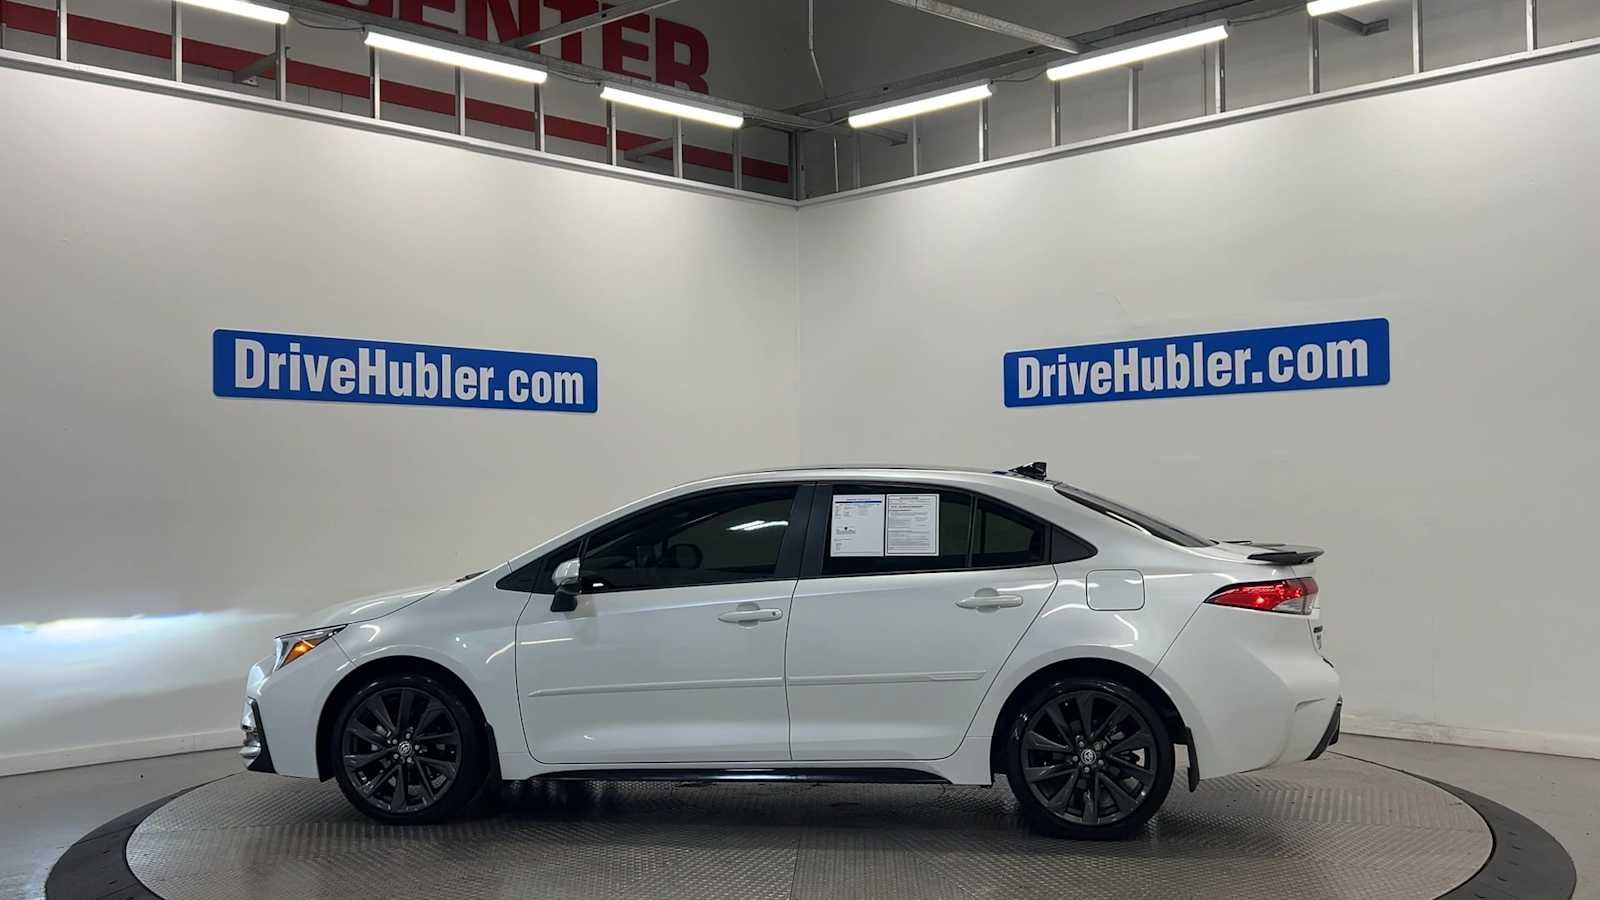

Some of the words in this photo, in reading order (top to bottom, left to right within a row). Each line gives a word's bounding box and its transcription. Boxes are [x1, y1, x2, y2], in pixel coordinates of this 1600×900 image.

[323, 0, 710, 95] NTER
[234, 338, 584, 405] DriveHubler.com
[1017, 338, 1368, 399] DriveHubler.com
